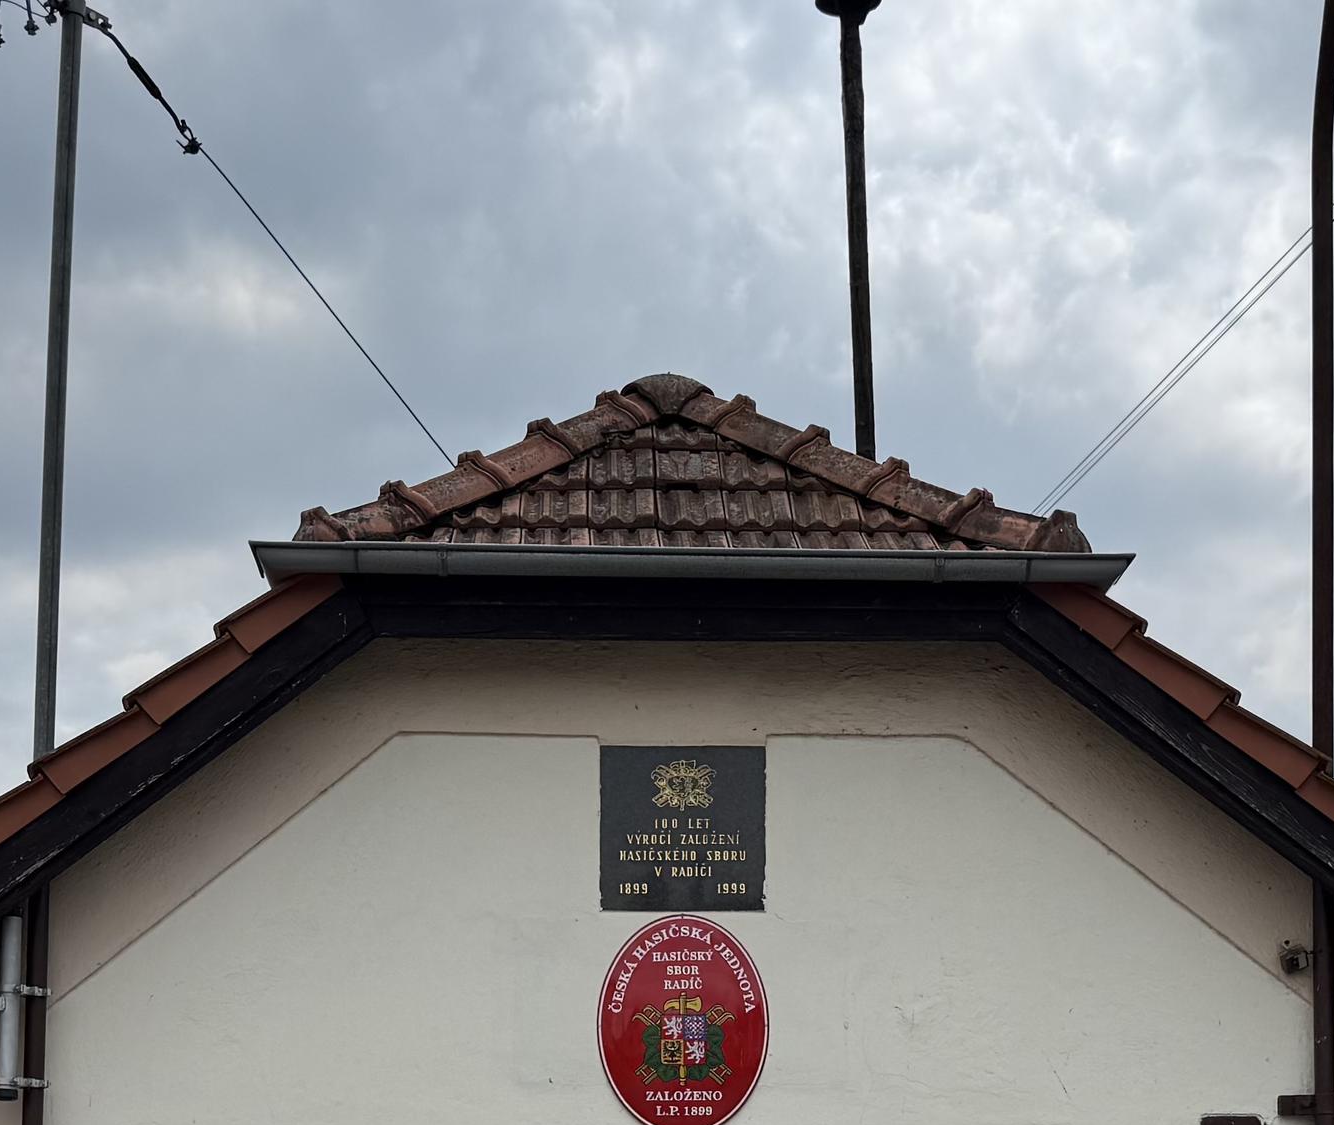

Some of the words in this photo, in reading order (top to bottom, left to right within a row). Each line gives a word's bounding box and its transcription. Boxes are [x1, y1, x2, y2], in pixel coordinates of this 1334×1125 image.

[655, 818, 678, 829] 100
[688, 818, 711, 829] LET
[627, 830, 671, 845] VÝROČÍ
[680, 830, 740, 845] ZALOŽENÍ
[619, 847, 697, 861] HASIČSKÉHO
[706, 850, 747, 861] SBORU
[654, 866, 663, 877] V
[671, 863, 712, 877] RADÍČI
[619, 883, 649, 895] 1899
[717, 883, 747, 895] 1999
[652, 948, 713, 962] HASIČSKÝ
[607, 959, 638, 1014] ČESKÁ
[631, 923, 714, 961] HASIČSKÁ
[713, 942, 756, 1014] JEDNOTA
[666, 965, 700, 976] SBOR
[663, 976, 703, 990] RADÍČ
[645, 1088, 723, 1101] ZALOŽENO
[656, 1105, 680, 1116] L.P.
[684, 1106, 713, 1116] 1899
